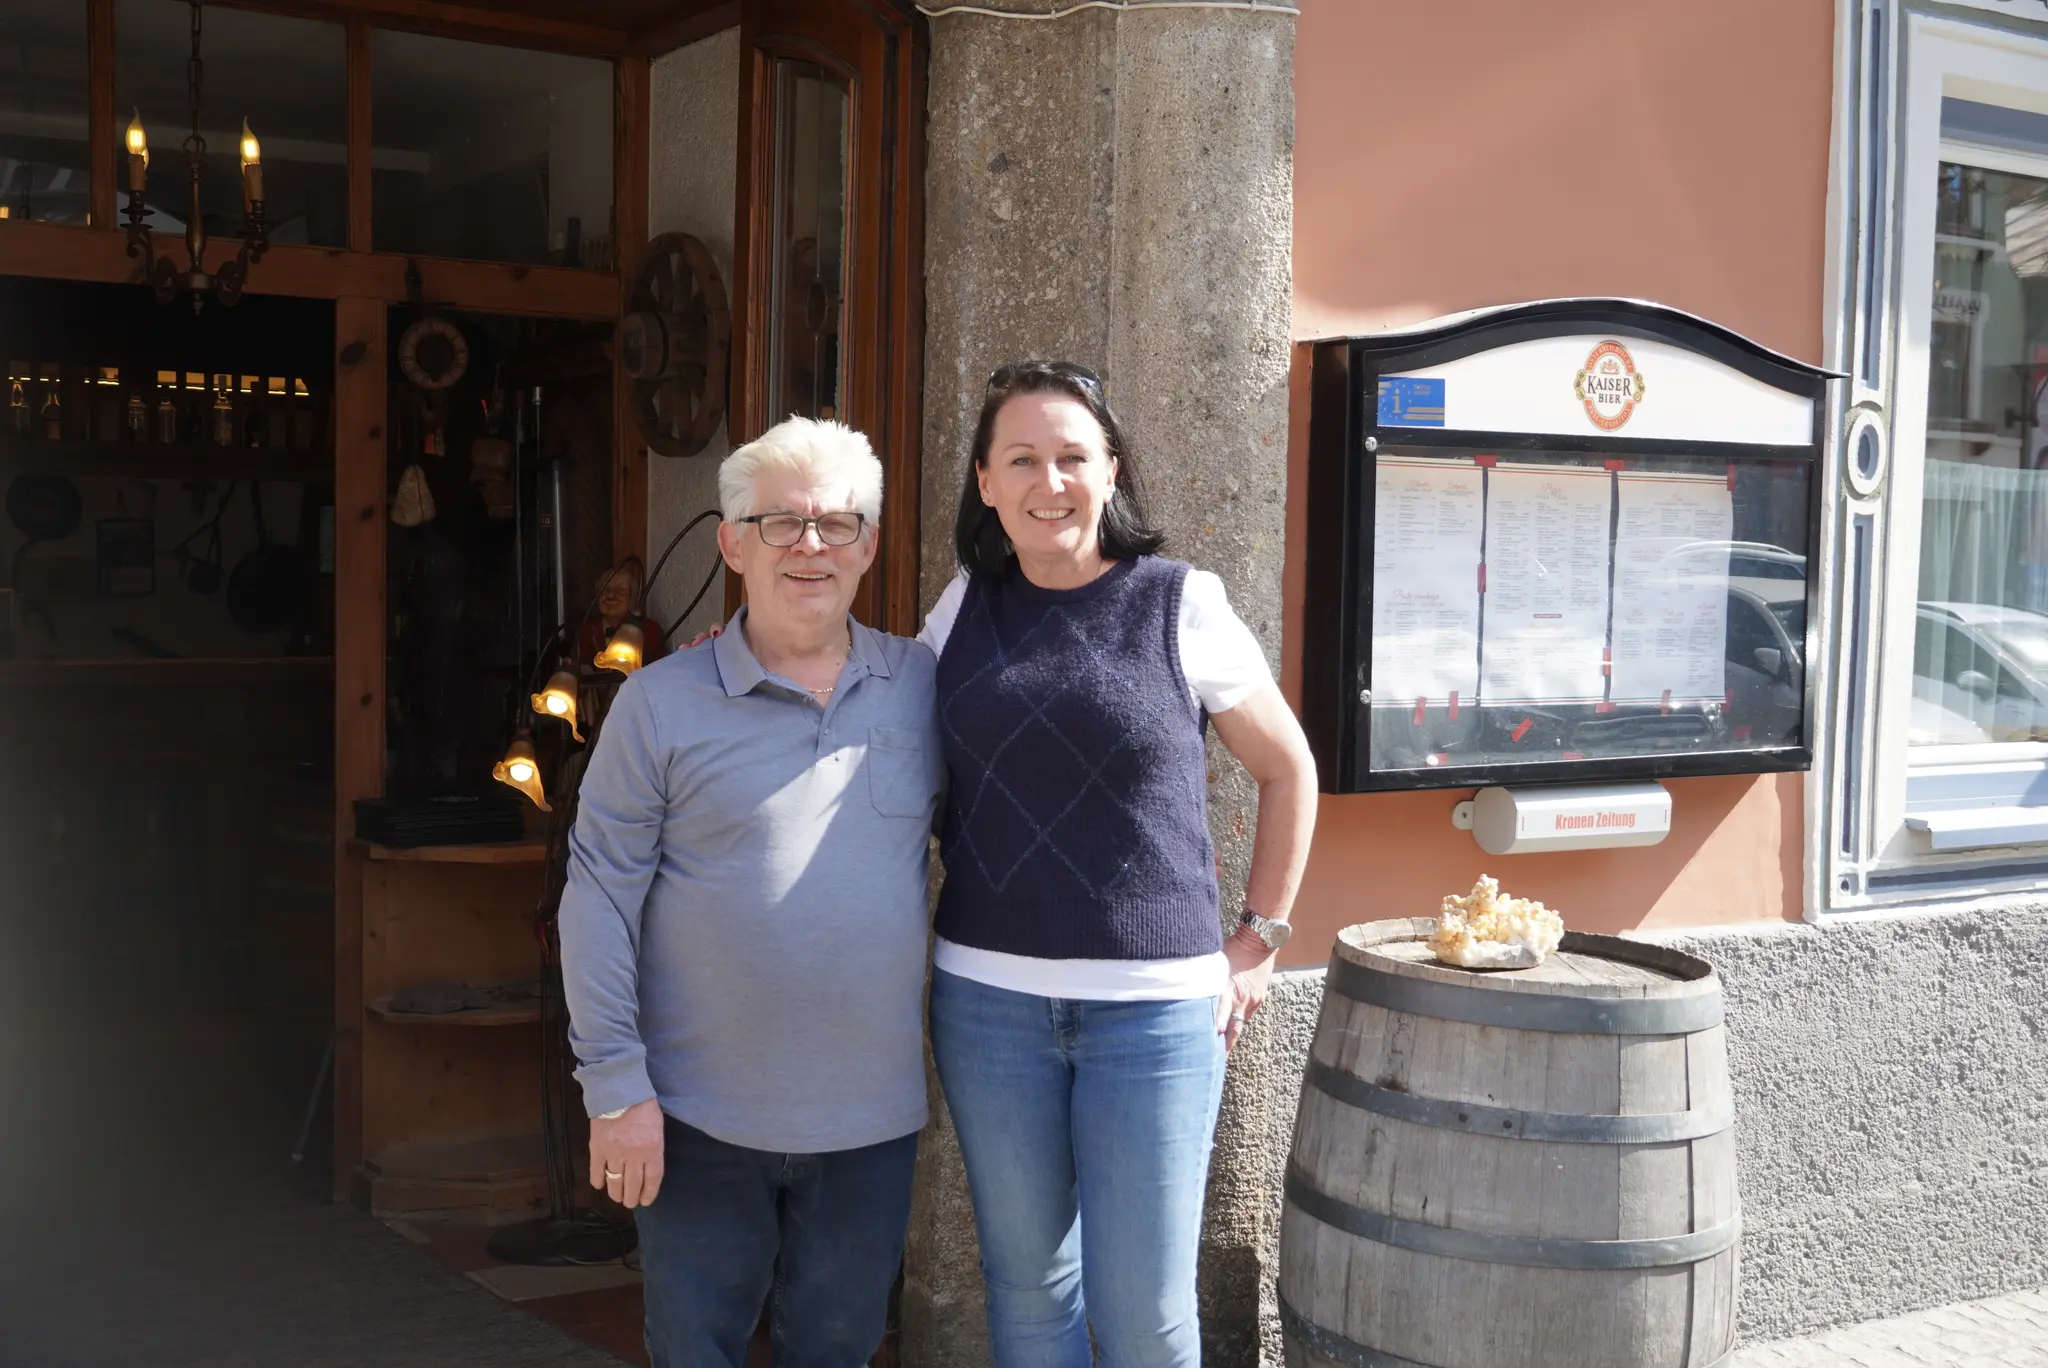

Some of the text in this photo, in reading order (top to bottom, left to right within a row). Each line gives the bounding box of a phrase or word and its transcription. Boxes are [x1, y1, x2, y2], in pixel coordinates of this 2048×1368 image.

[1587, 375, 1632, 396] KAISER
[1598, 393, 1622, 404] BIER
[1555, 812, 1636, 830] Kronen Zeitung
